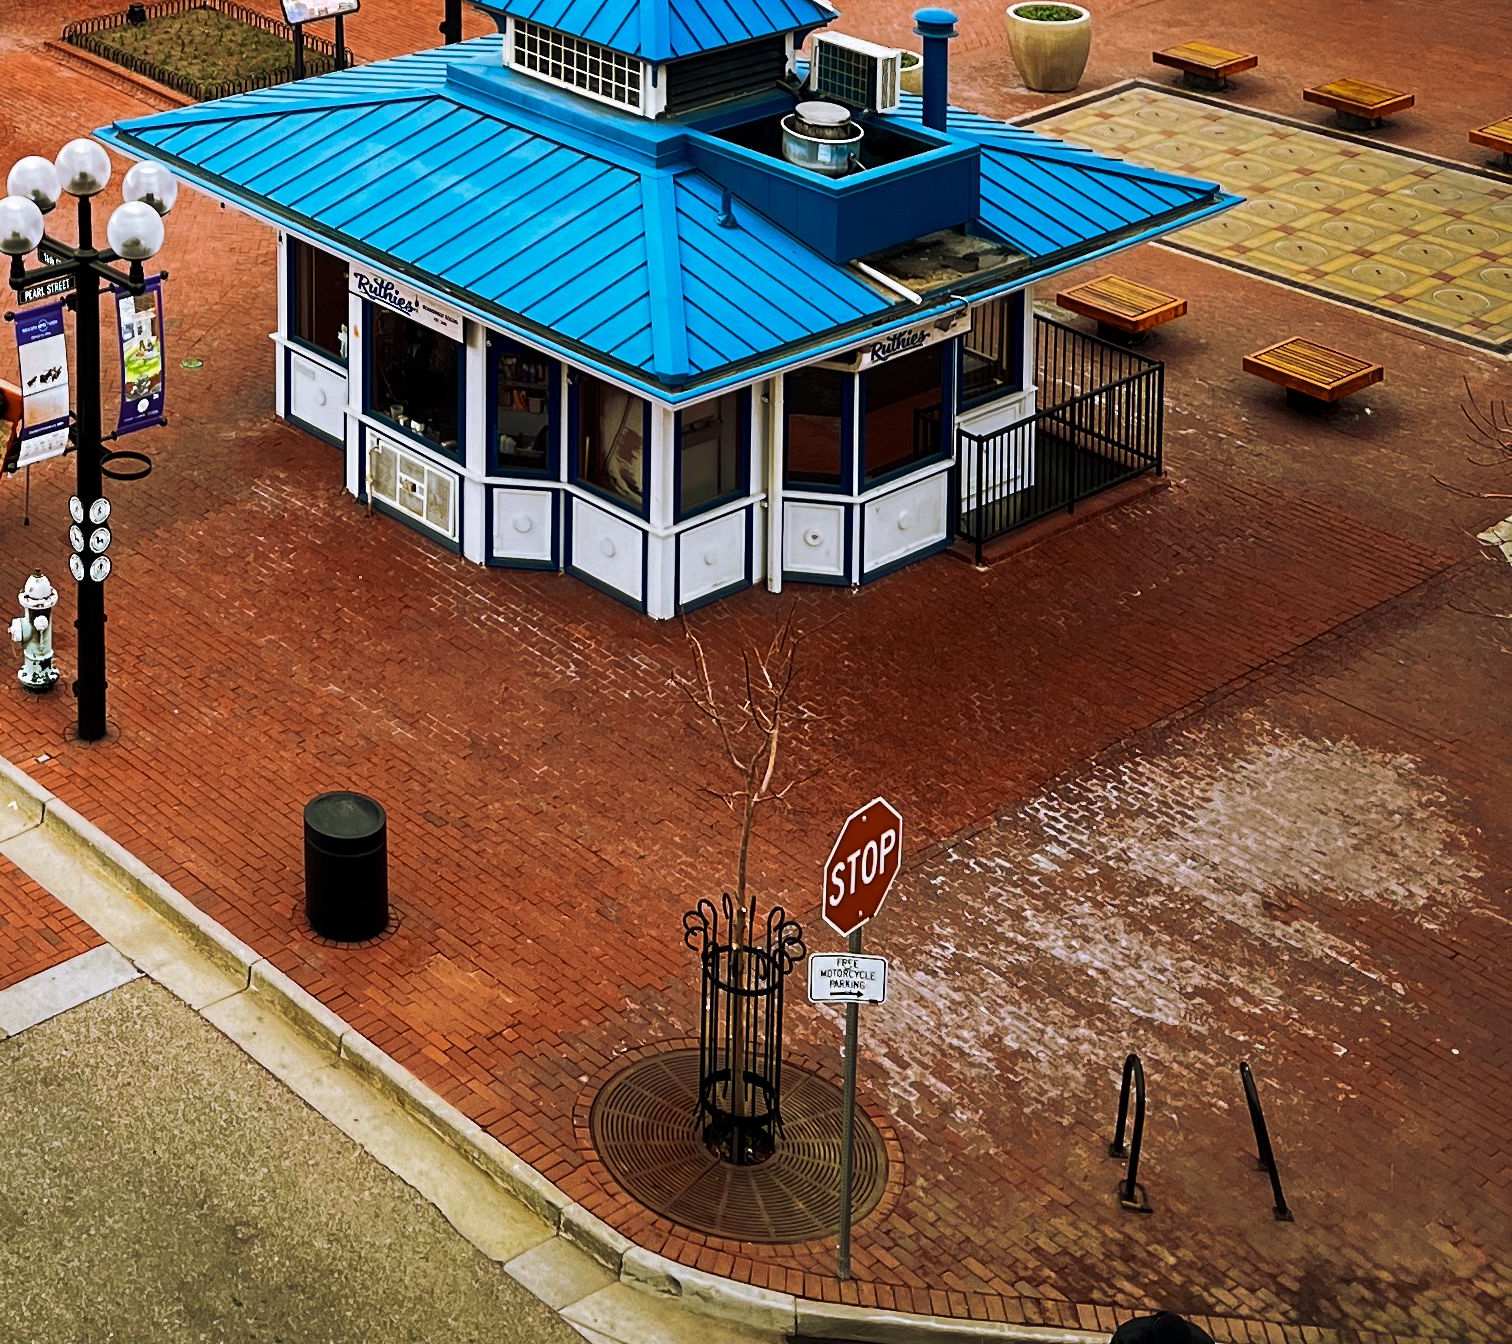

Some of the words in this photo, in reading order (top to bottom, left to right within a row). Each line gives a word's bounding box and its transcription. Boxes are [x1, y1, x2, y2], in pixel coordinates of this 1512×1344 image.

[25, 287, 45, 301] PEARL
[47, 279, 70, 294] STREET
[829, 828, 896, 907] STOP
[836, 958, 860, 968] FREE
[821, 968, 876, 981] MOTORCYCLE
[829, 979, 866, 990] PARKING
